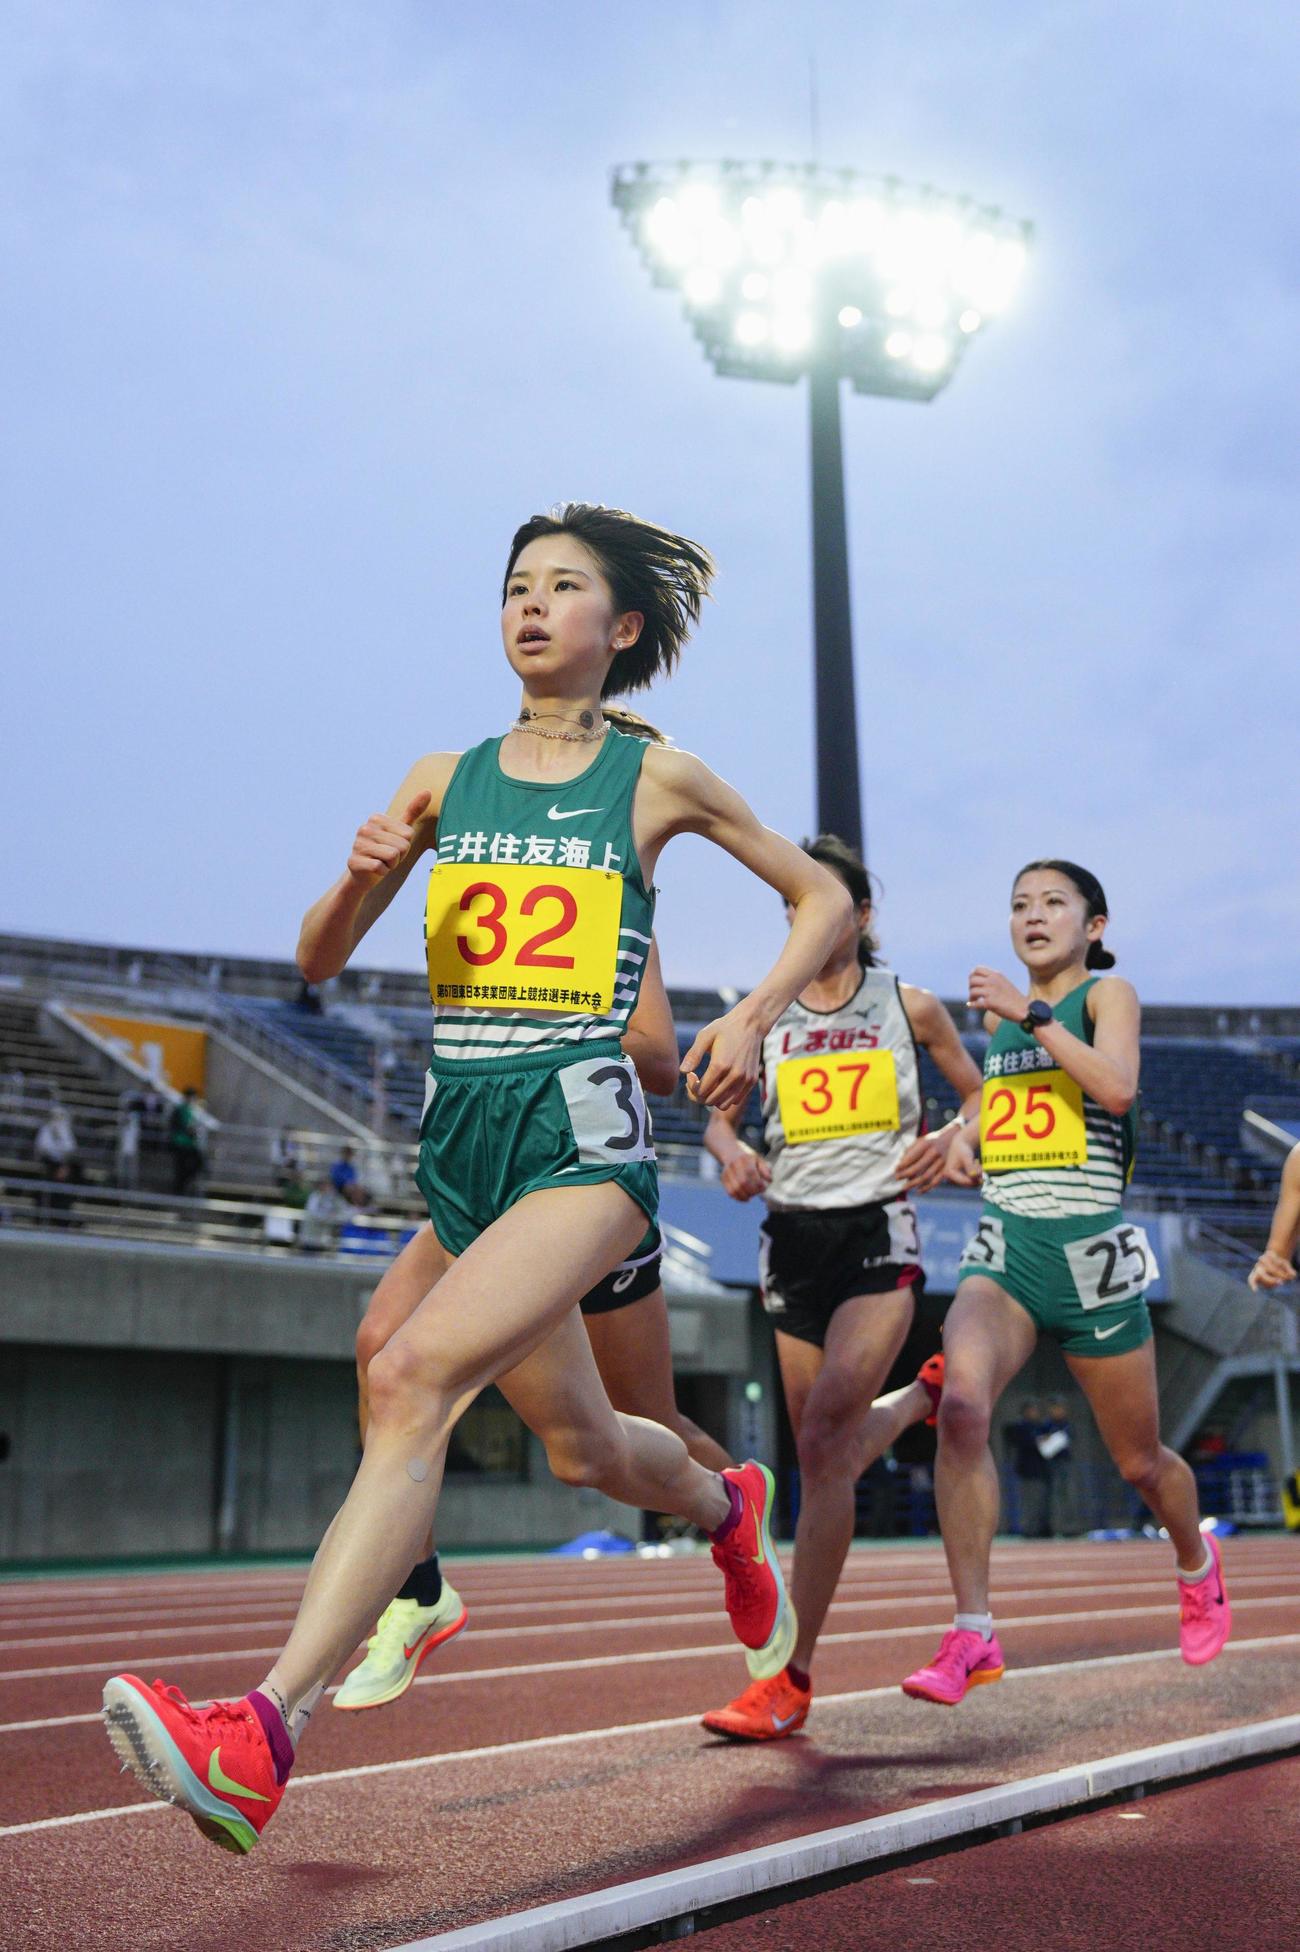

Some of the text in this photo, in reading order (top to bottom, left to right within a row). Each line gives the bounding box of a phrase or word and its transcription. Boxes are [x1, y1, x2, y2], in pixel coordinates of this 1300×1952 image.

[437, 832, 622, 874] 三井住友海上
[457, 881, 578, 969] 32
[782, 1024, 881, 1055] しまむら
[587, 1065, 653, 1150] 3
[800, 1063, 870, 1116] 37
[985, 1084, 1056, 1142] 25
[1085, 1227, 1147, 1299] 25
